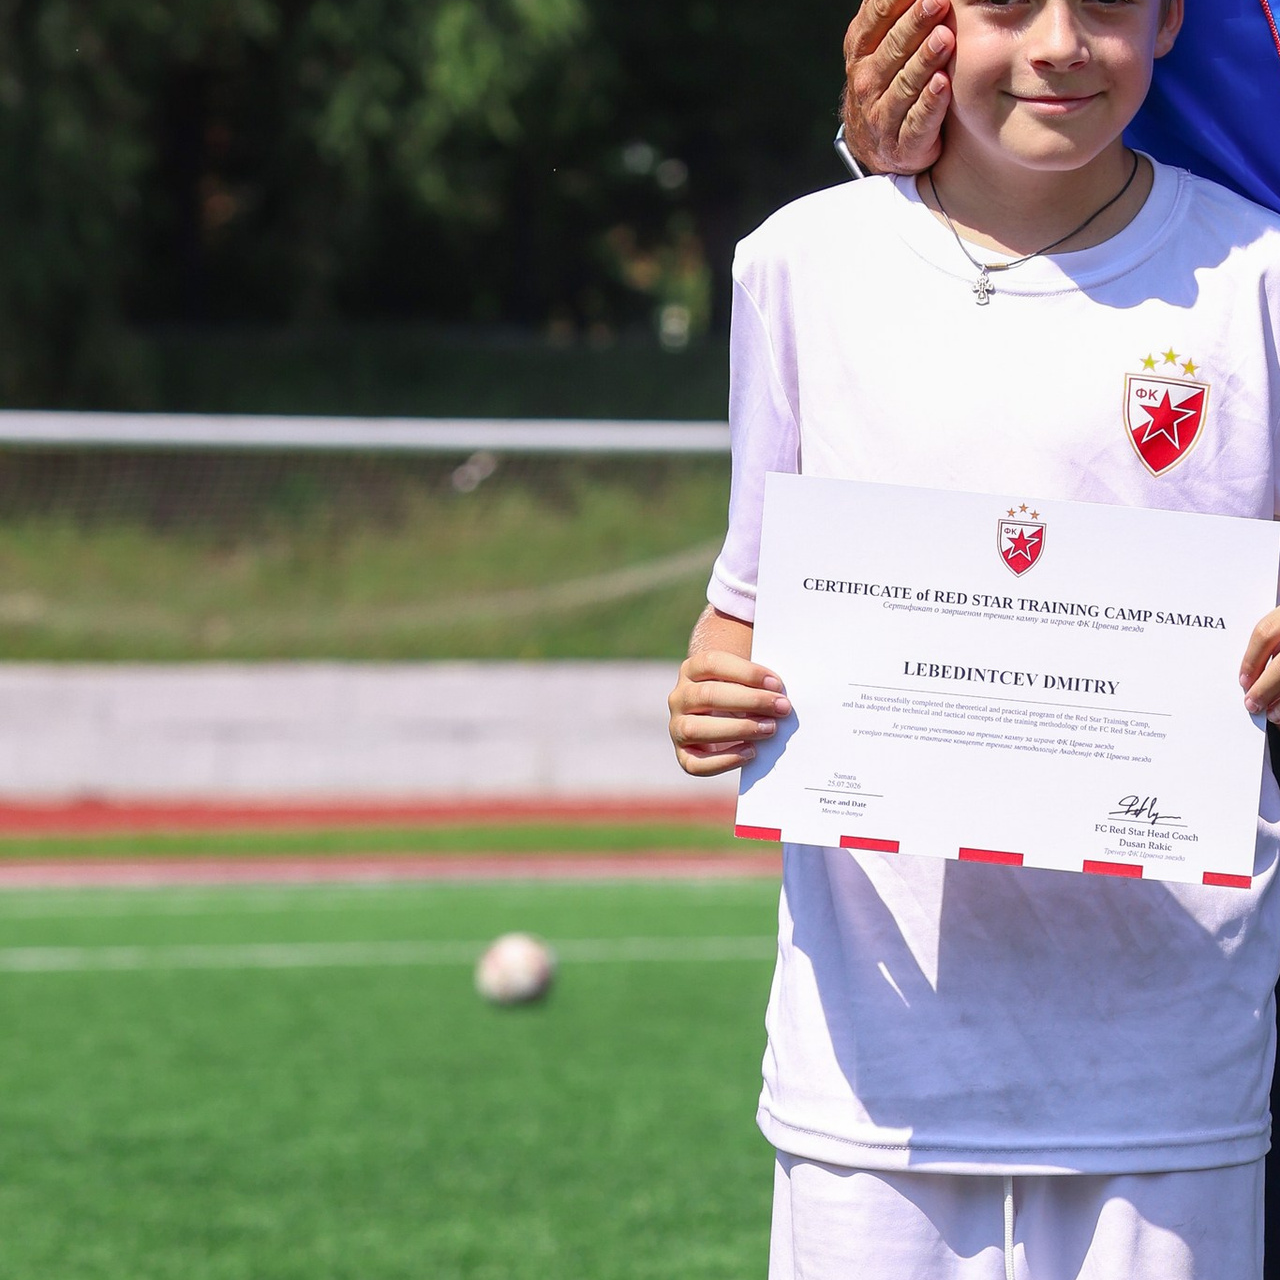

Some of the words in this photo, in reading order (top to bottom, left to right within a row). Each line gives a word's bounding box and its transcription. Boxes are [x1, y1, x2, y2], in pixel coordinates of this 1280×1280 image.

[1135, 388, 1158, 401] ФК
[803, 578, 911, 599] CERTIFICATE
[917, 589, 930, 601] of
[935, 591, 967, 604] RED
[972, 595, 1012, 609] STAR
[1018, 599, 1098, 617] TRAINING
[1105, 607, 1152, 621] CAMP
[1156, 612, 1225, 629] SAMARA
[883, 601, 932, 612] Сертификат
[1016, 616, 1038, 624] кампу
[1092, 621, 1119, 630] Црвена
[904, 662, 1038, 686] LEBEDINTCEV
[1044, 675, 1119, 694] DMITRY
[874, 696, 910, 705] successfully
[956, 703, 987, 712] theoretical
[1029, 711, 1054, 719] program
[1103, 717, 1128, 727] Training
[1130, 720, 1150, 728] Camp,
[902, 707, 929, 715] technical
[1014, 719, 1037, 727] training
[1039, 721, 1077, 731] methodology
[1138, 730, 1167, 739] Academy
[828, 780, 861, 789] 25.07.2026
[834, 772, 856, 780] Samara
[1095, 824, 1107, 832] FC
[1109, 826, 1125, 834] Red
[1128, 827, 1145, 836] Star
[1147, 829, 1169, 838] Head
[1172, 832, 1198, 841] Coach
[1119, 839, 1145, 848] Dusan
[1149, 842, 1172, 851] Rakic
